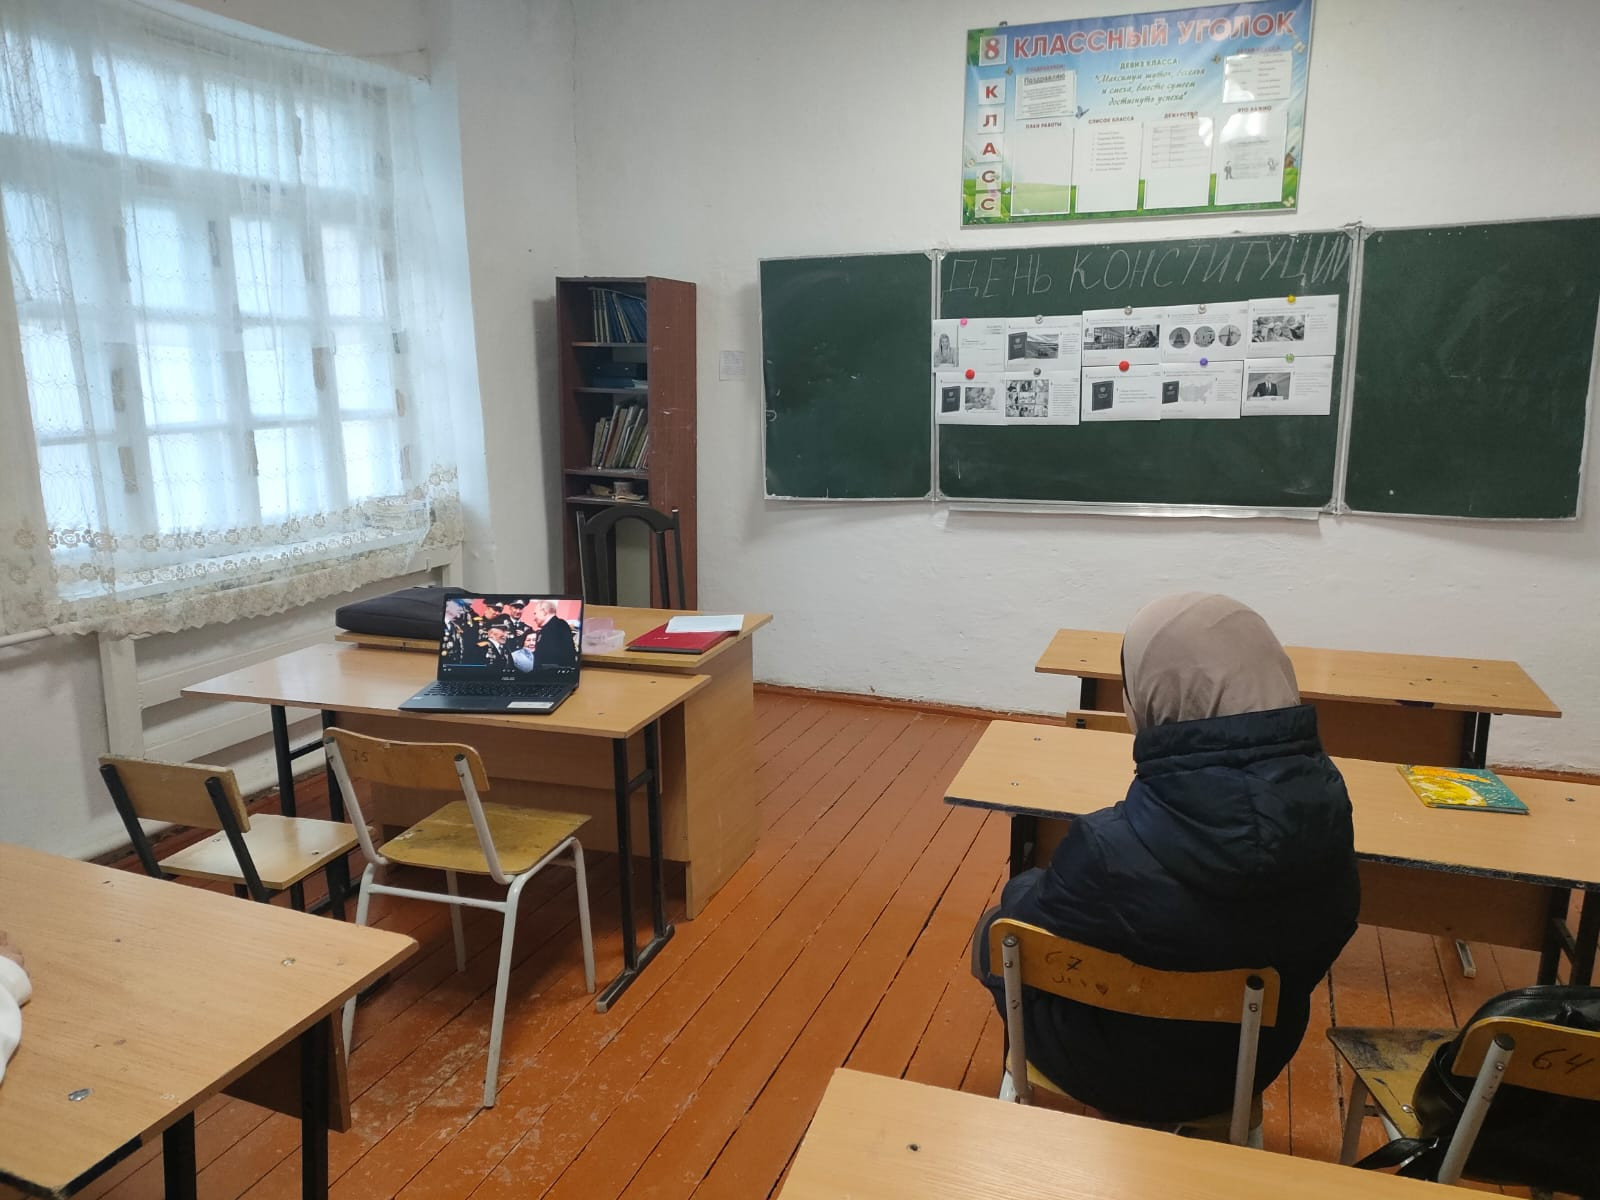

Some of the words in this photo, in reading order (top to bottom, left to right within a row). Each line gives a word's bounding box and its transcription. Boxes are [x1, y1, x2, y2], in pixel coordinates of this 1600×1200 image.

[1013, 17, 1168, 60] КЛАССНЫЙ
[1178, 10, 1297, 46] УГОЛОК
[984, 38, 1000, 61] 8
[1119, 60, 1145, 70] ДЕВИЗ
[942, 253, 1052, 300] ДЕНЬ
[1069, 234, 1351, 294] КОНСТИТУЦИИ
[1531, 1048, 1595, 1075] 64
